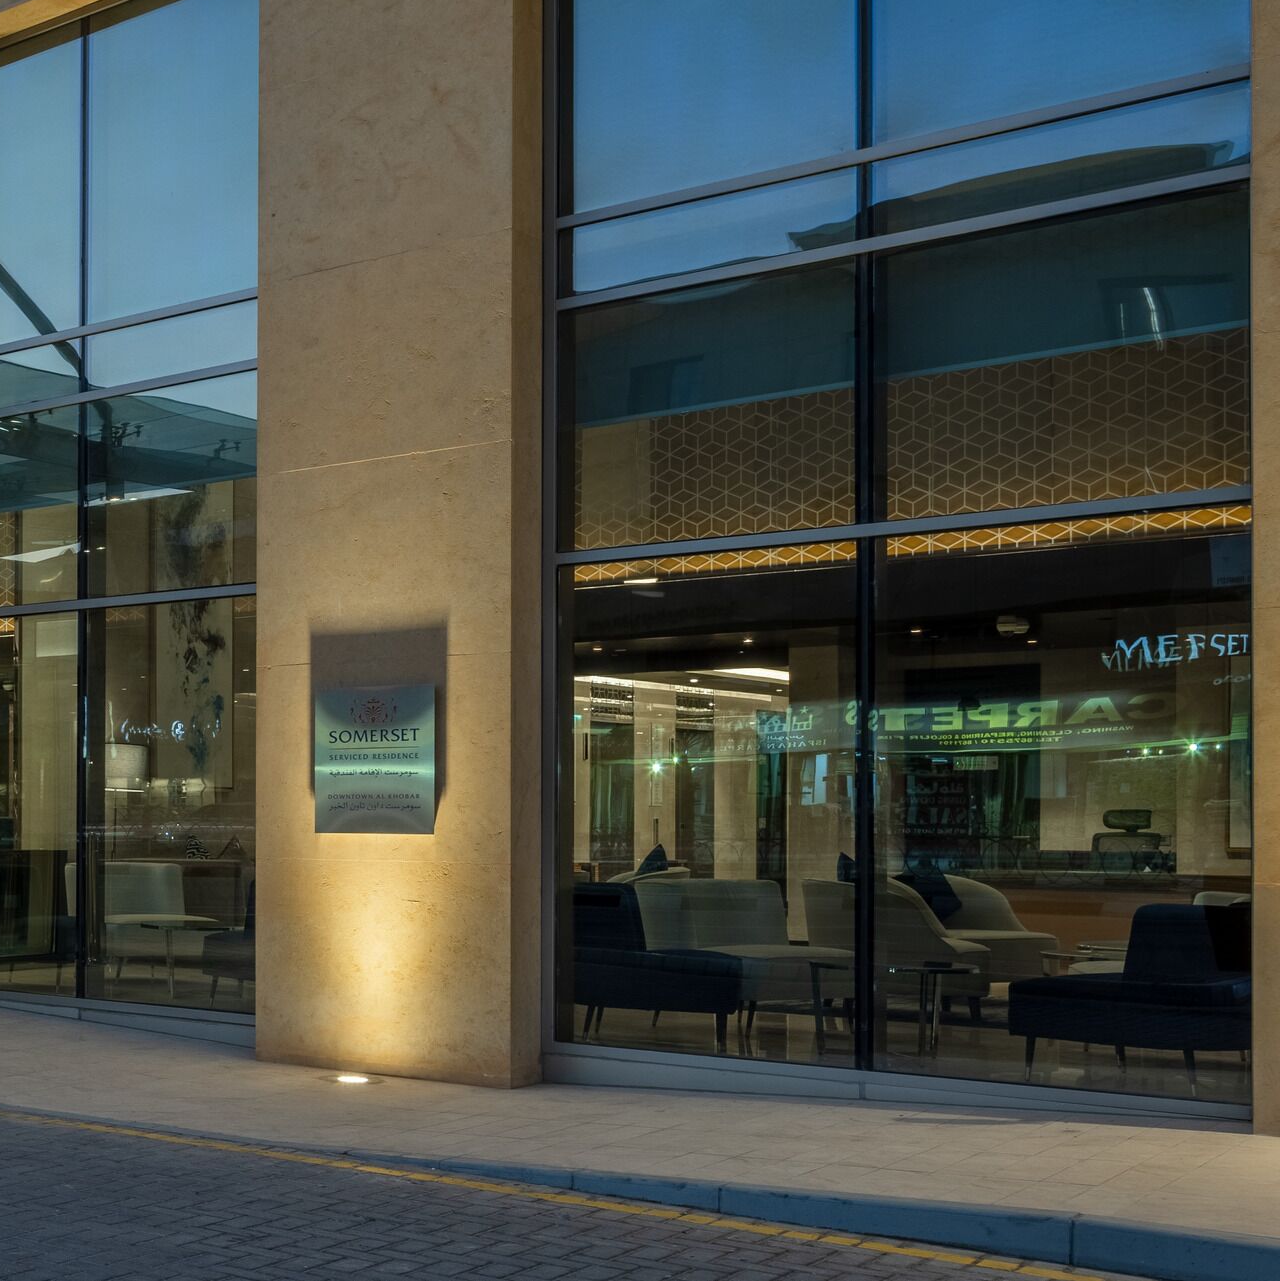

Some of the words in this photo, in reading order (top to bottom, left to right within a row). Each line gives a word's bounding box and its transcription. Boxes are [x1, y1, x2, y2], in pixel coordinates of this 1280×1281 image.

[328, 728, 420, 744] SOMERSET
[328, 753, 369, 761] SERVICED
[372, 752, 420, 760] RESIDENCE
[358, 768, 383, 779] الإقامة
[384, 768, 419, 778] سومرست
